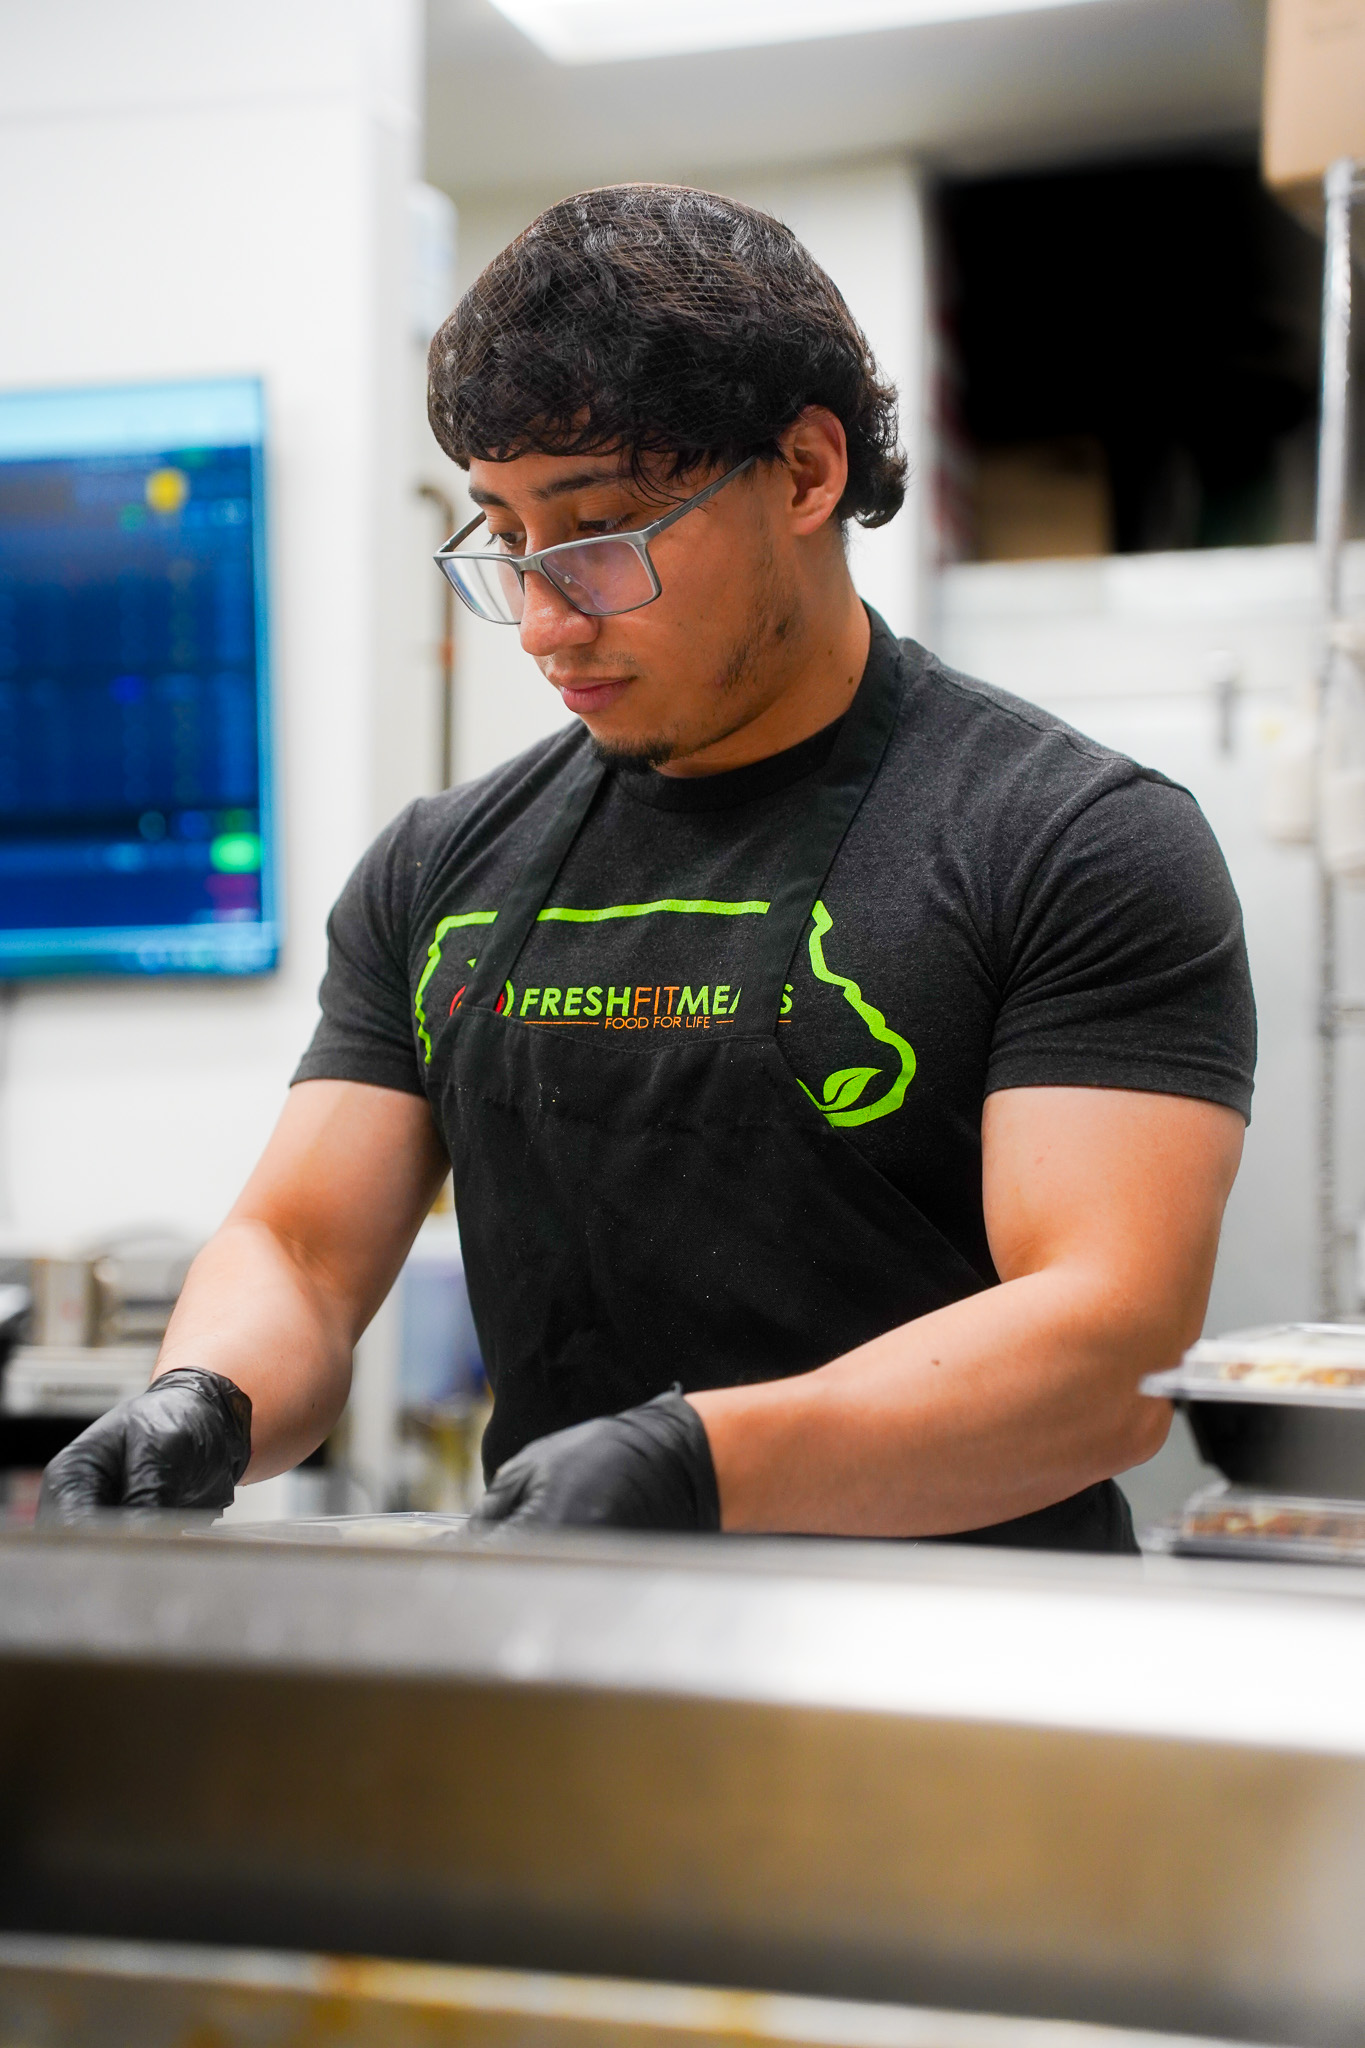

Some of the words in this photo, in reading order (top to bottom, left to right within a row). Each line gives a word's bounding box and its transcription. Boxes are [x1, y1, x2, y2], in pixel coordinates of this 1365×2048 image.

[519, 983, 794, 1017] FRESHFITMES
[604, 1016, 649, 1030] FOOD
[653, 1016, 682, 1029] FOR
[685, 1016, 711, 1029] LIFE
